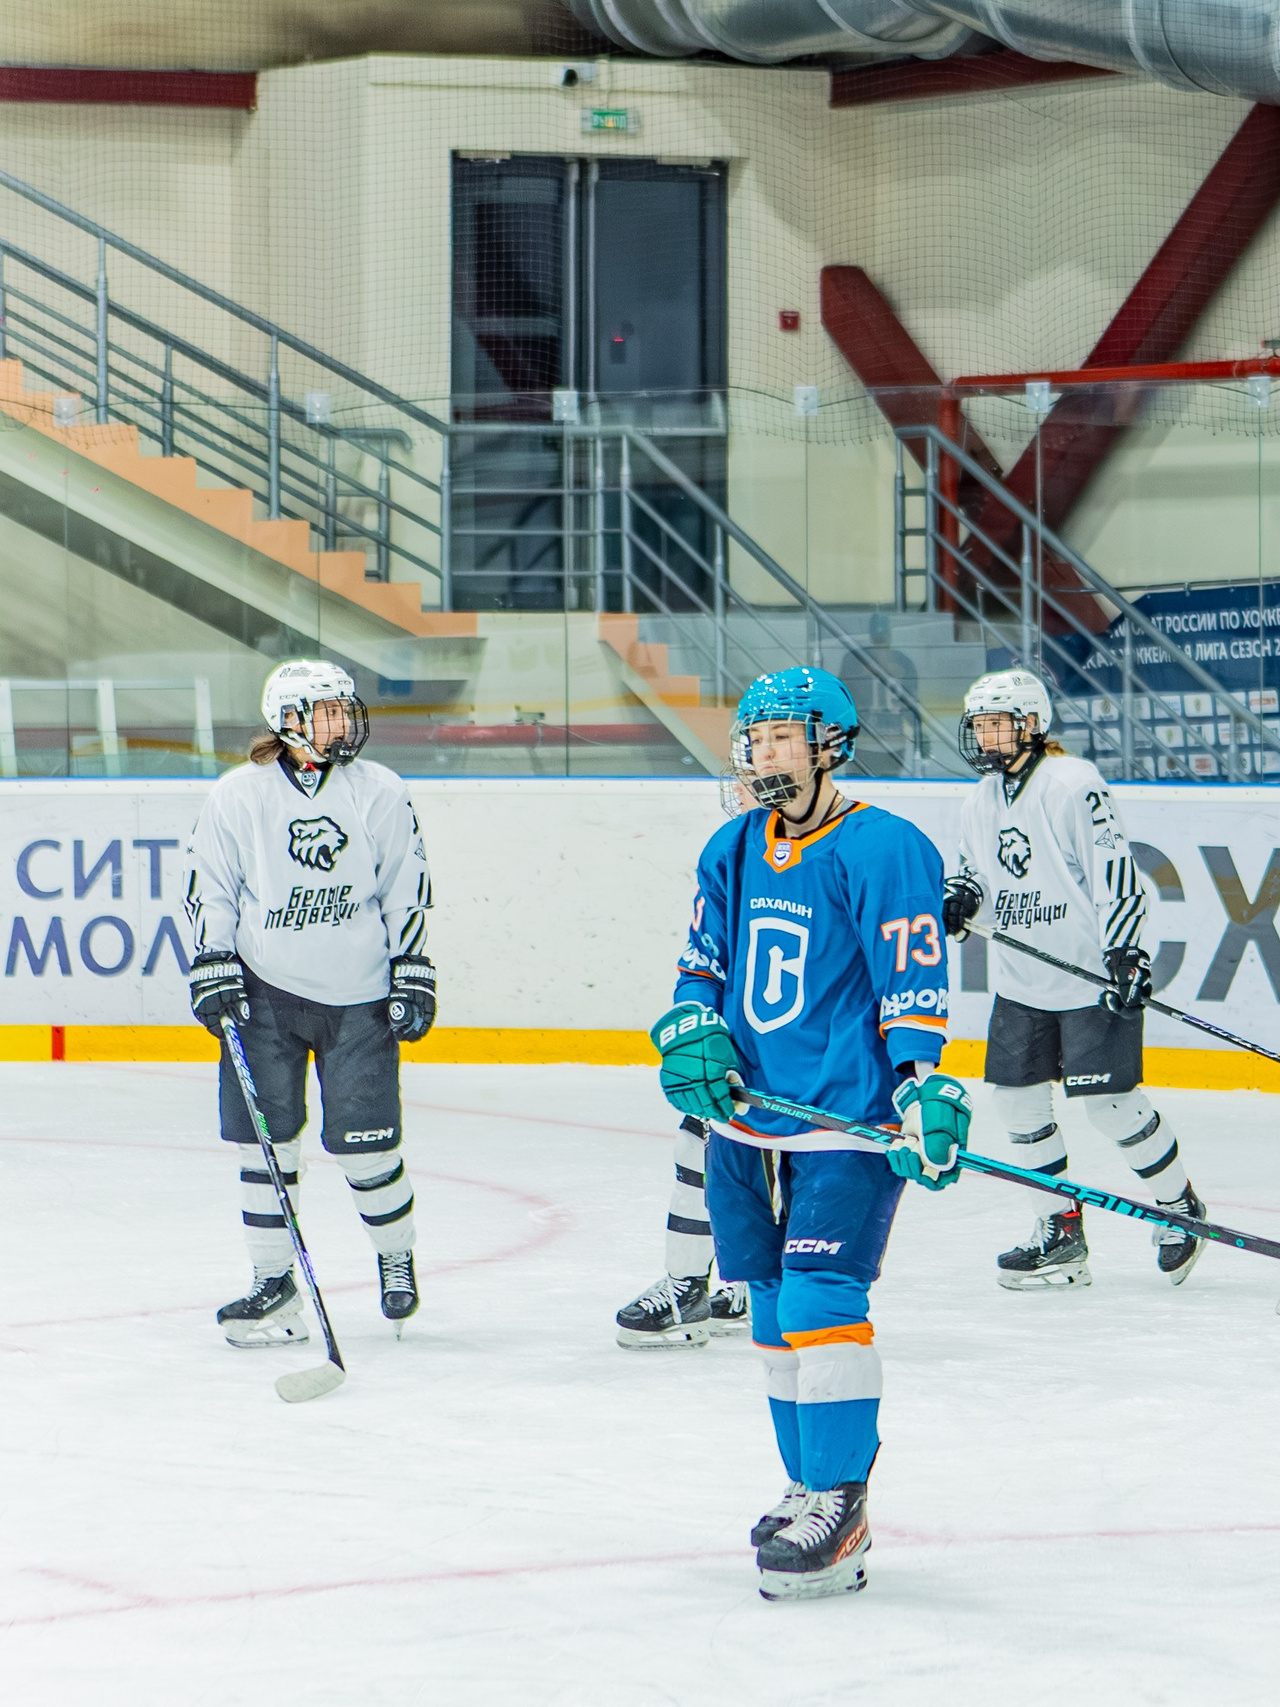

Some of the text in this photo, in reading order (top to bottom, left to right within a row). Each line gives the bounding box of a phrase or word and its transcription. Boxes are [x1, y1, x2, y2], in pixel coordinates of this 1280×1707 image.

[1165, 612, 1217, 633] РОССИИ
[1220, 611, 1240, 630] ПО
[1195, 642, 1228, 661] ЛИГА
[749, 897, 813, 919] САХАЛИН
[881, 914, 942, 973] 73
[1065, 1073, 1111, 1087] CCM
[344, 1127, 395, 1143] CCM
[784, 1238, 843, 1255] CCM
